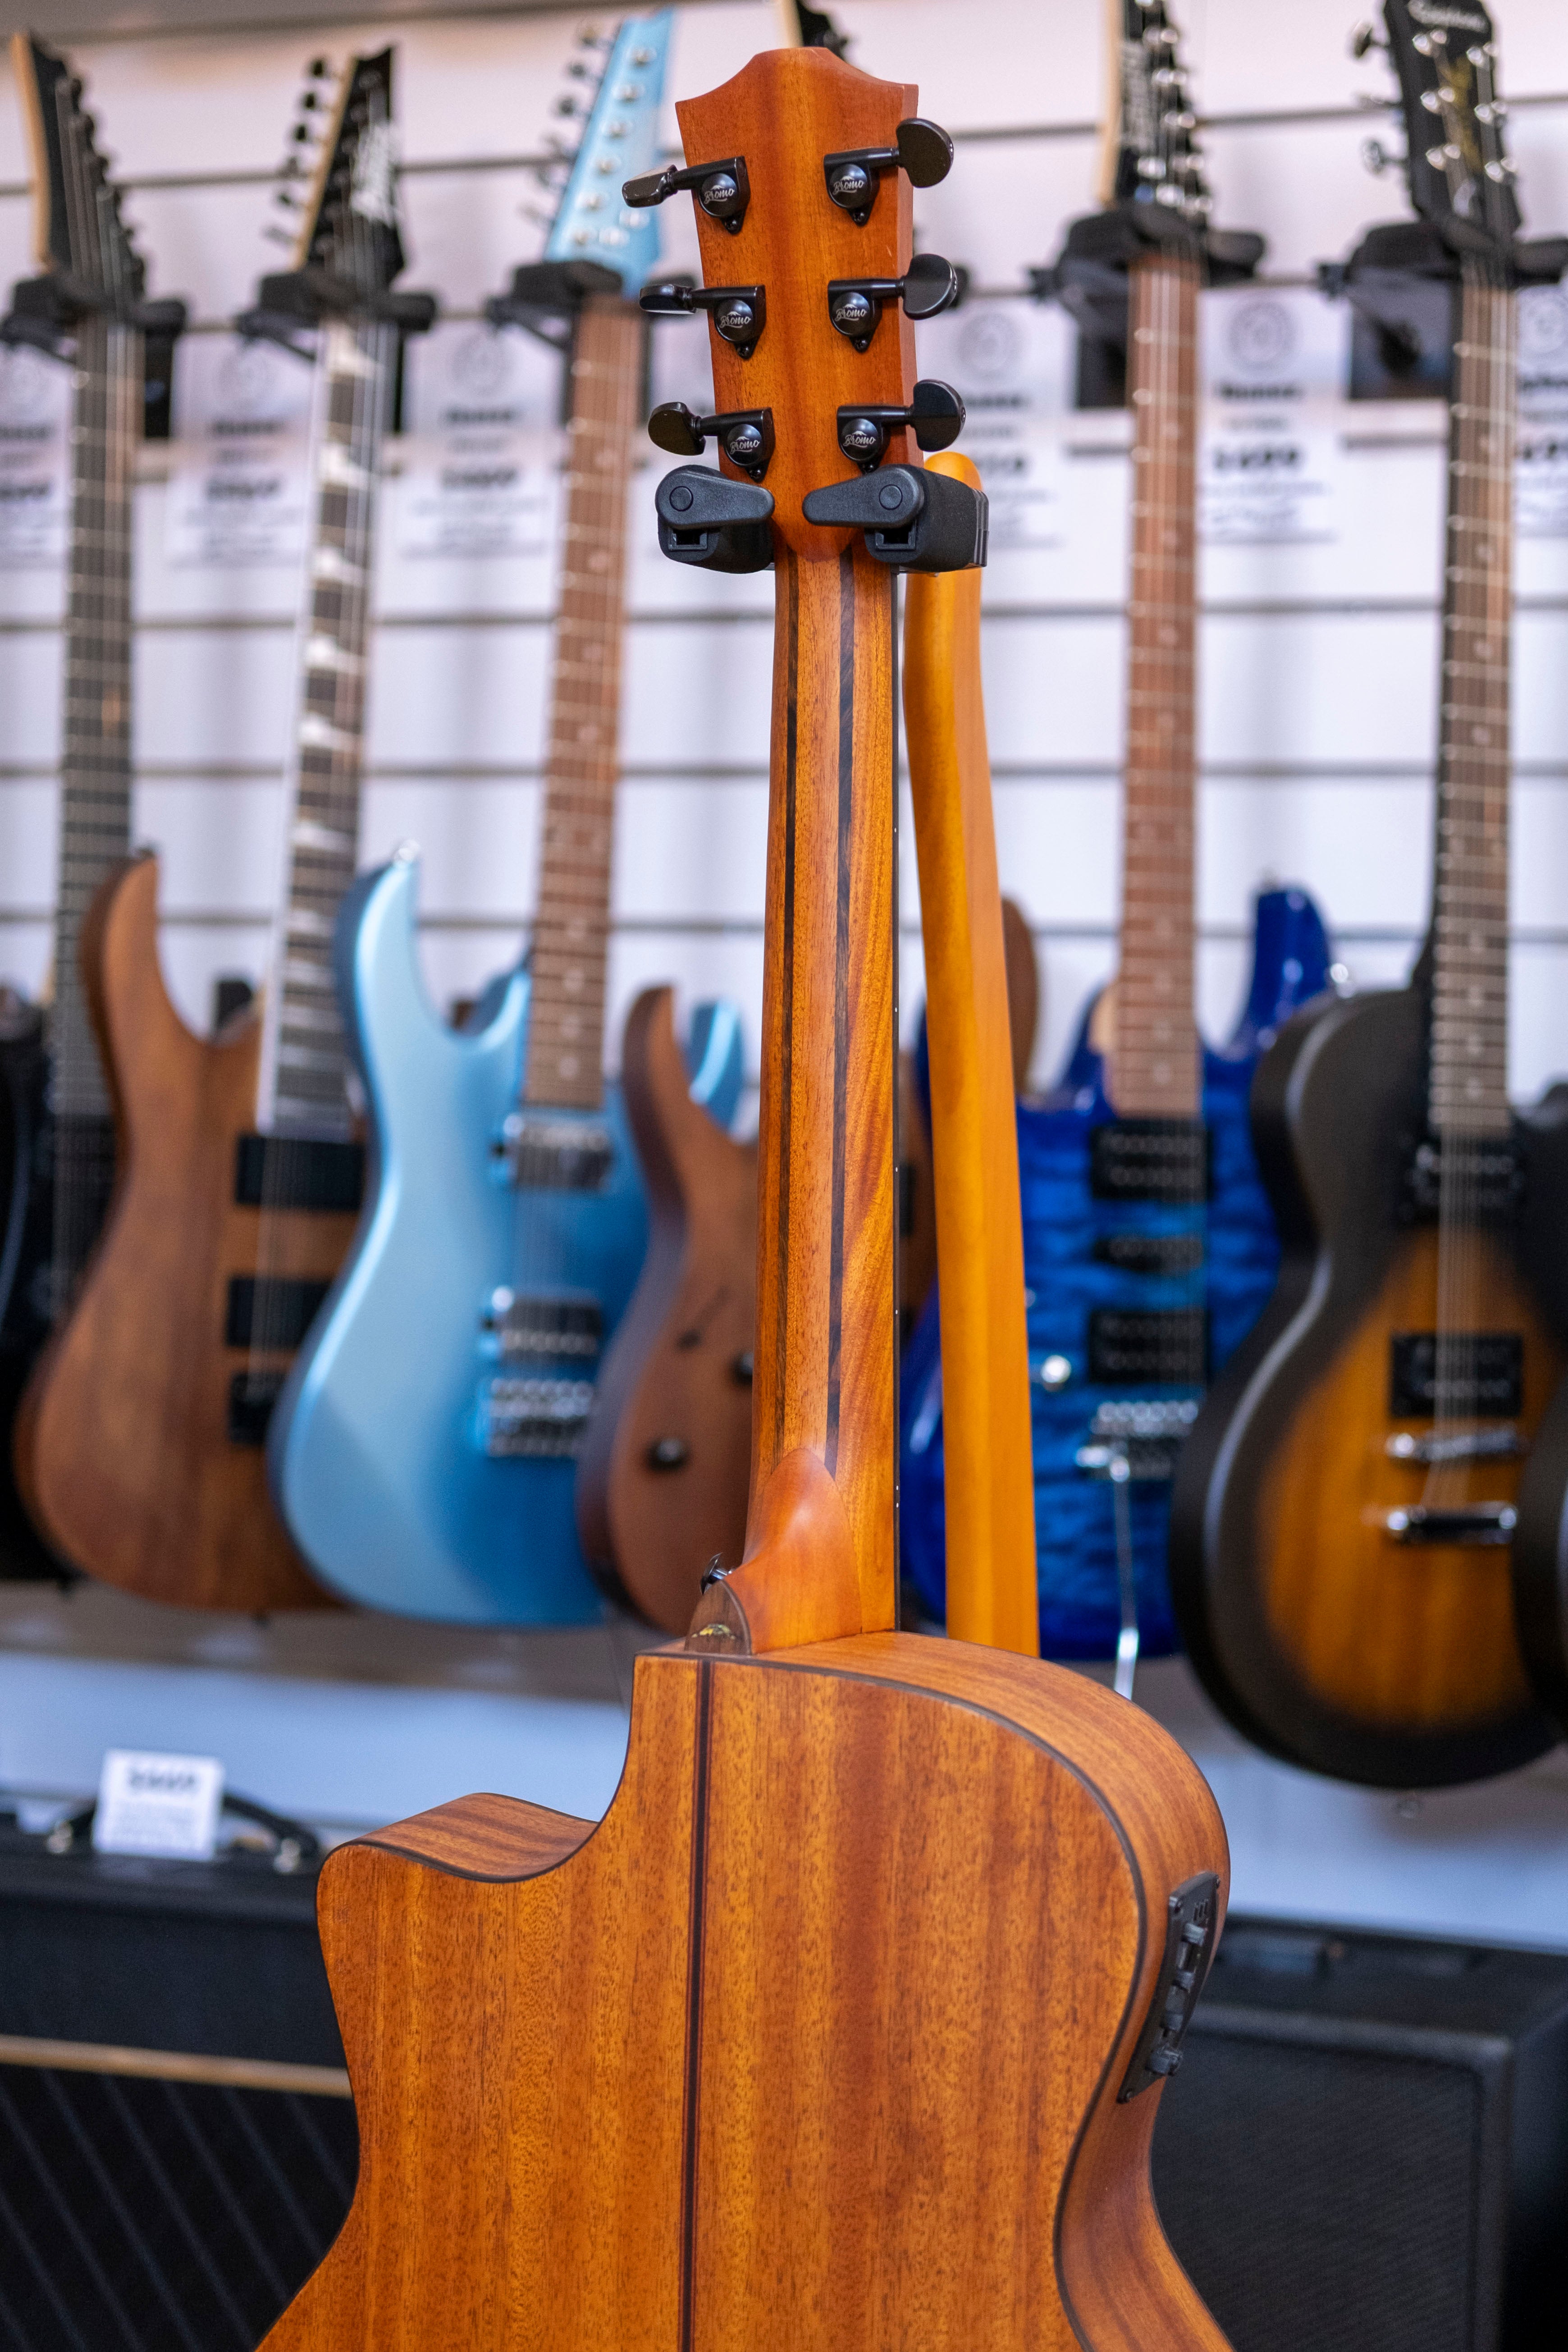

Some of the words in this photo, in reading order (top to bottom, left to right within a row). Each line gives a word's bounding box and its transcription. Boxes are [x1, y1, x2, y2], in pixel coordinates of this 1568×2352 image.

[832, 179, 865, 195] Bromo
[704, 188, 735, 204] Bromo
[719, 315, 751, 328] Bromo
[834, 308, 868, 321] Bromo
[730, 439, 760, 454] Bromo
[842, 434, 876, 448] Bromo
